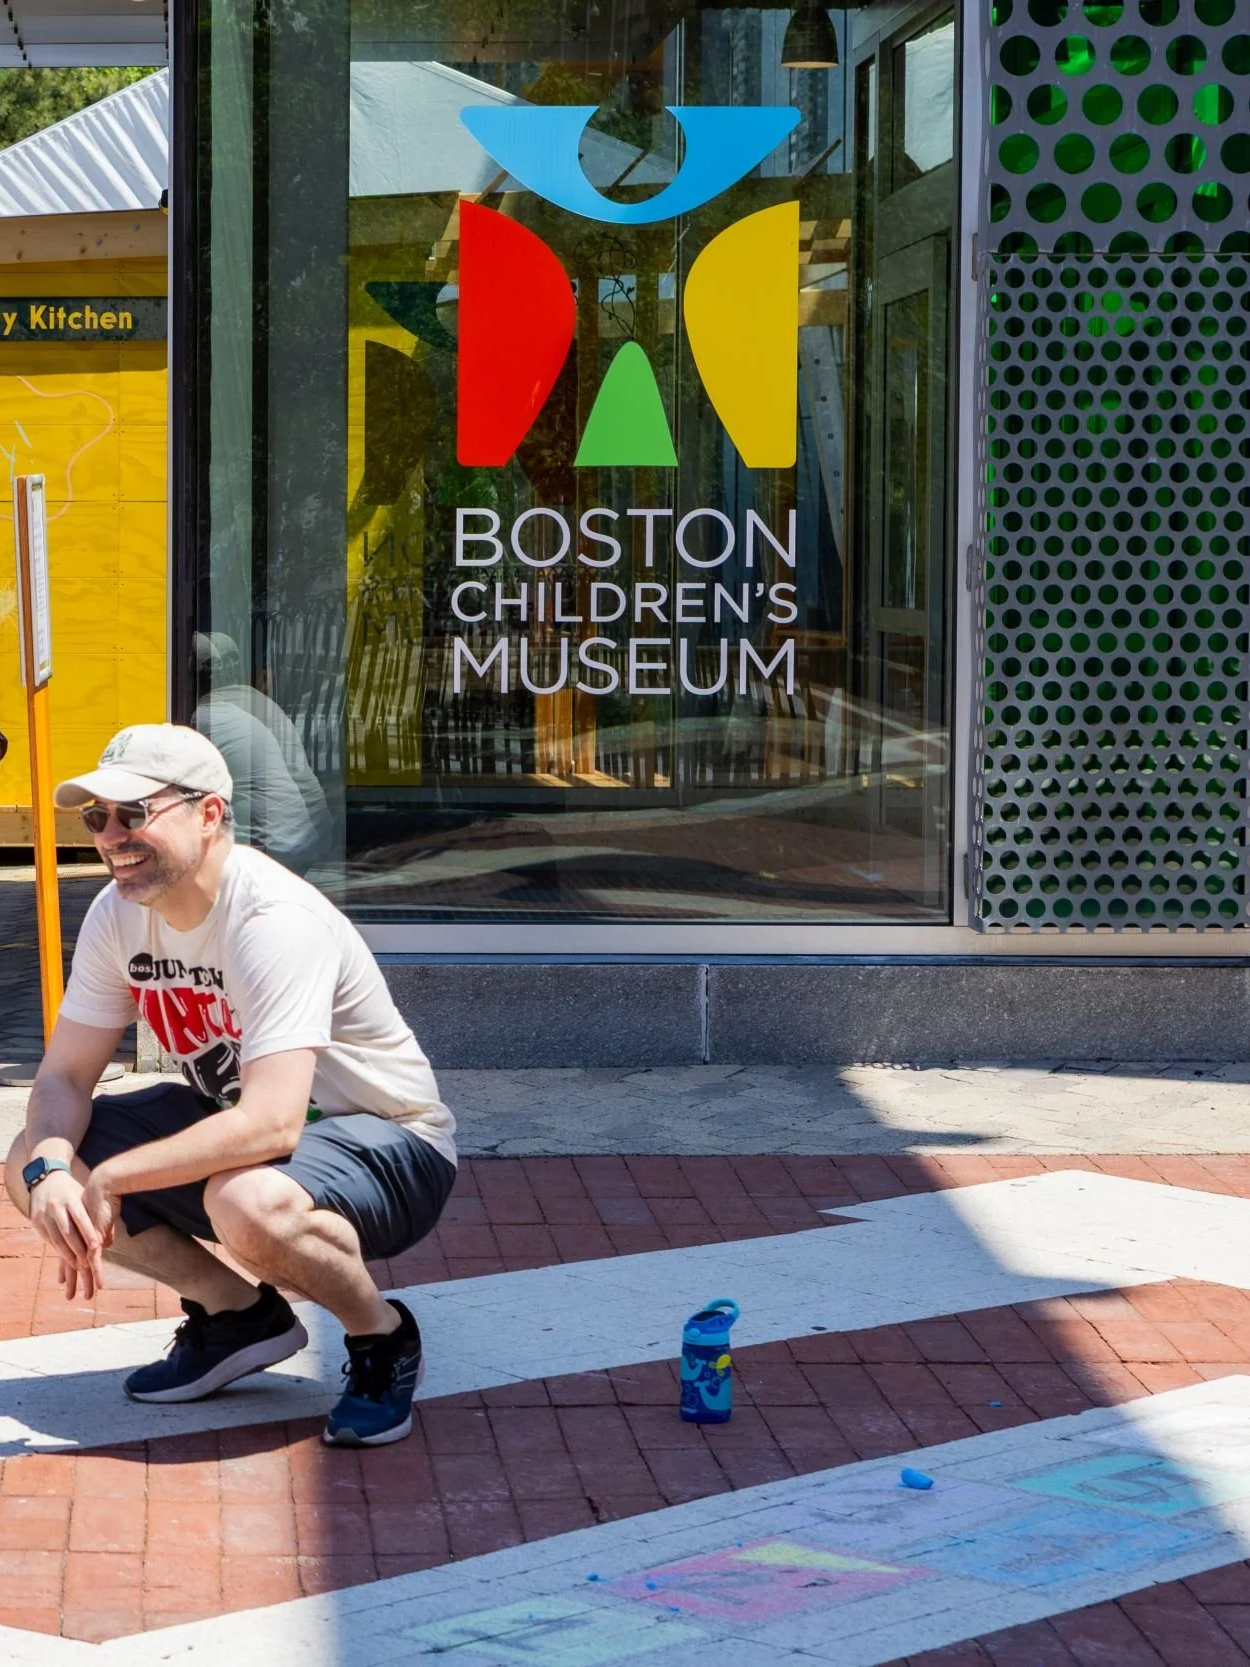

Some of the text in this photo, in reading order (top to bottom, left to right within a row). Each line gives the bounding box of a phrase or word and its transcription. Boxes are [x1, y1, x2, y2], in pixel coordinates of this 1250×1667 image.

[30, 304, 133, 330] Kitchen
[455, 507, 797, 568] BOSTON
[450, 582, 798, 623] CHILDREN'S
[453, 637, 795, 695] MUSEUM
